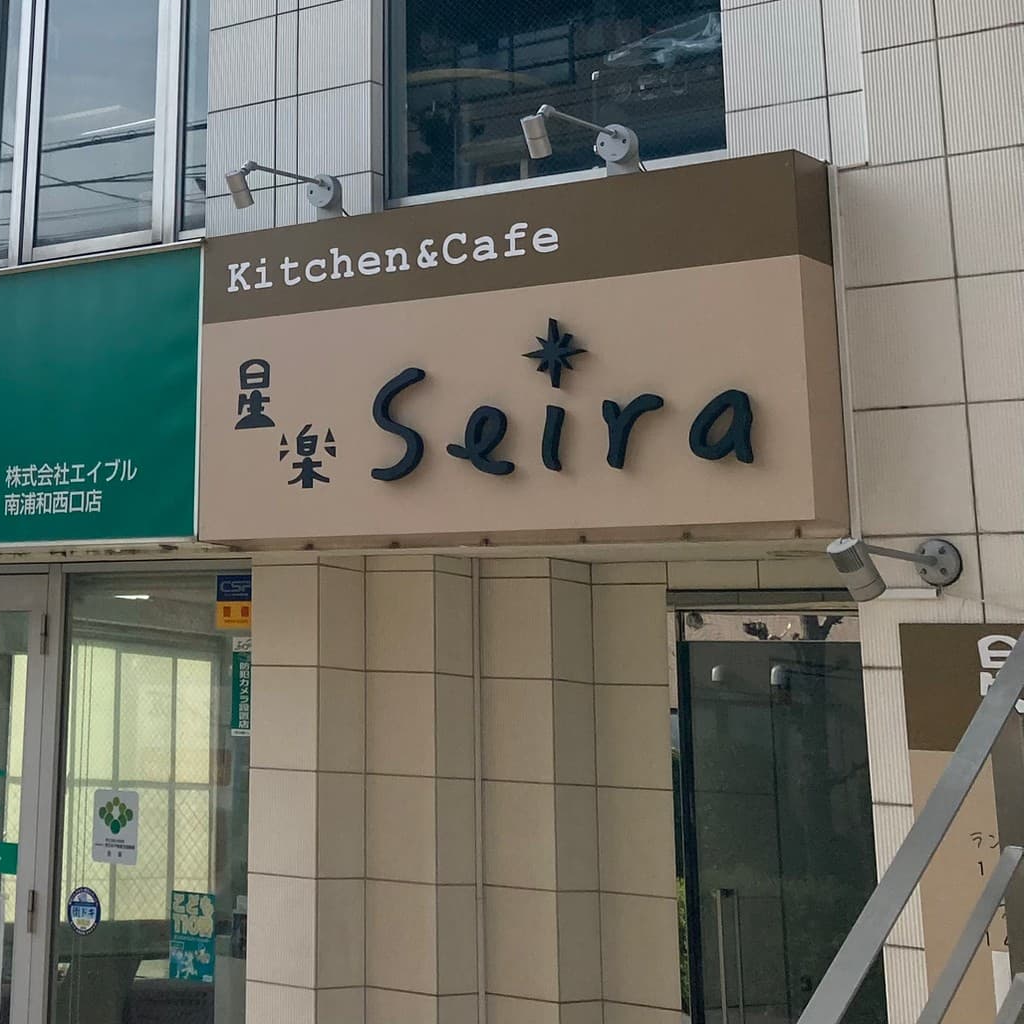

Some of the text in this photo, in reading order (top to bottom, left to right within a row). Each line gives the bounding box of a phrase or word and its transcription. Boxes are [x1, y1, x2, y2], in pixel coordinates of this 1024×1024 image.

[227, 222, 559, 292] Kitchen&Cafe
[371, 317, 754, 482] Seira
[5, 458, 138, 488] 株式会社エイブル
[4, 489, 102, 516] 南浦和西口店
